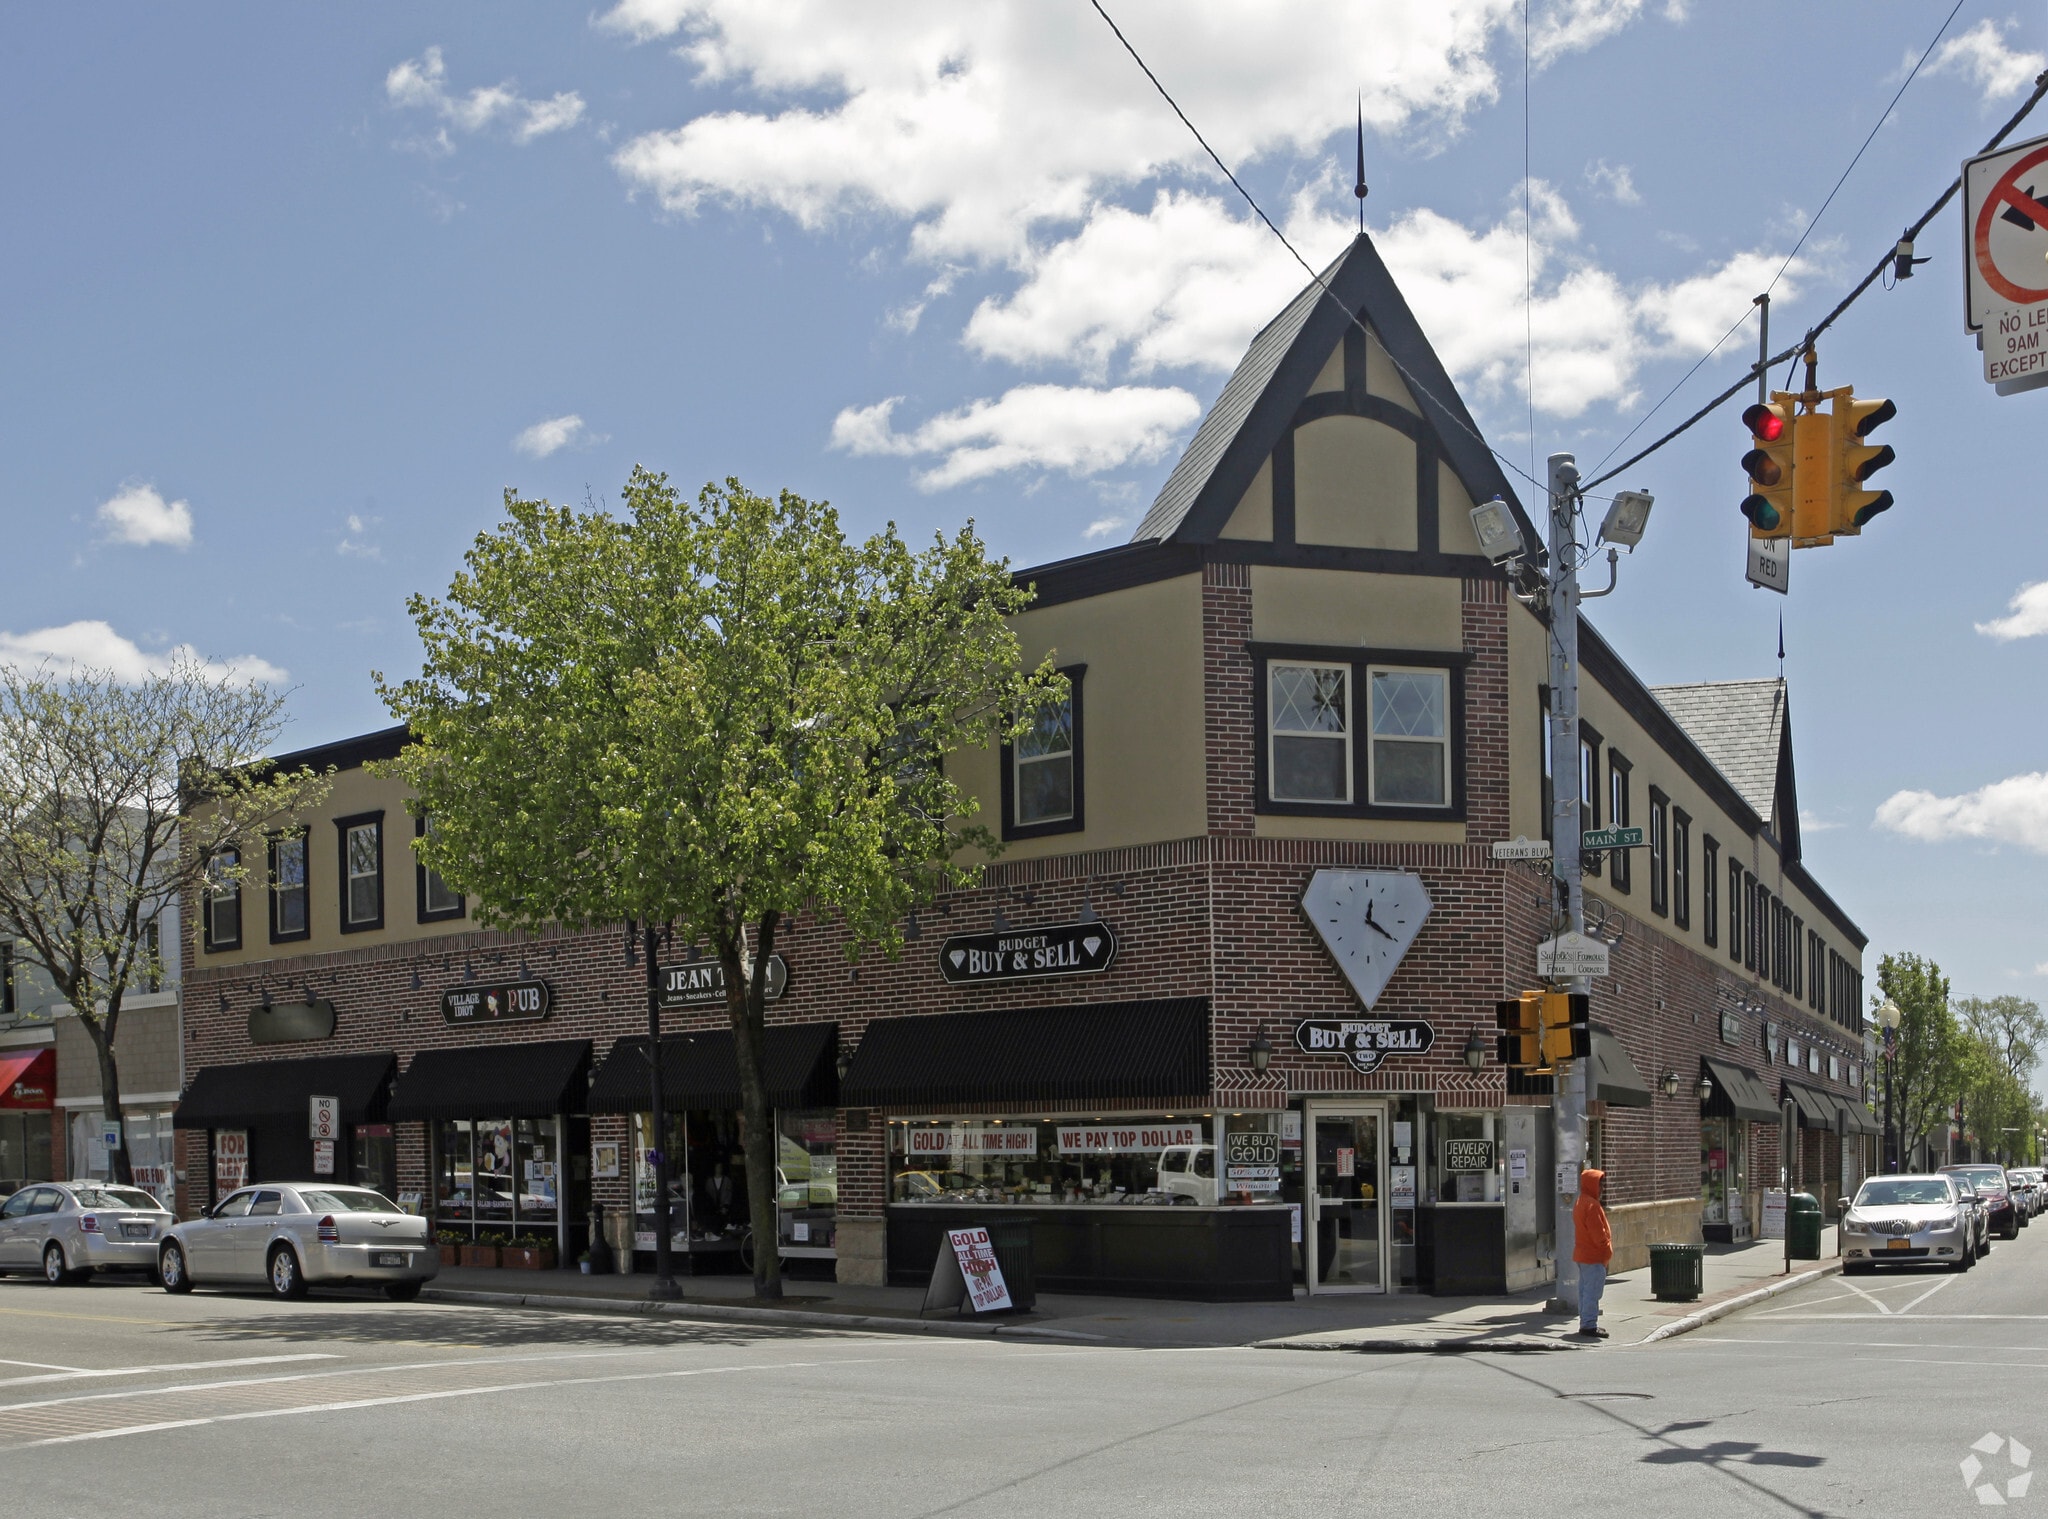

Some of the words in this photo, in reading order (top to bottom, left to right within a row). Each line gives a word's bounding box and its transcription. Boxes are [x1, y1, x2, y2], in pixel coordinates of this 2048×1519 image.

[2000, 315, 2021, 335] NO
[2029, 308, 2048, 328] LE
[2007, 332, 2039, 354] 9AM
[1990, 351, 2047, 379] EXCEPT
[1760, 556, 1777, 578] RED
[1585, 834, 1617, 846] MAIN
[1624, 832, 1641, 843] ST.
[1494, 847, 1529, 858] VETERANS
[1532, 847, 1549, 857] BLVD
[998, 935, 1048, 951] BUDGET
[969, 949, 1006, 974] BUY
[1012, 952, 1028, 970] &
[1034, 939, 1081, 968] SELL
[1577, 951, 1605, 961] Famous
[1578, 964, 1604, 974] Corners
[666, 968, 712, 991] JEAN
[448, 993, 480, 1006] VILLAGE
[507, 987, 540, 1012] PUB
[454, 1005, 474, 1017] IDIOT
[1340, 1022, 1391, 1034] BUDGET
[1309, 1026, 1349, 1048] BUY
[1355, 1033, 1371, 1048] &
[1376, 1028, 1422, 1049] SELL
[319, 1099, 330, 1108] NO
[221, 1135, 245, 1154] FOR
[913, 1132, 944, 1151] GOLD
[945, 1134, 961, 1150] AT
[962, 1133, 979, 1150] ALL
[981, 1133, 1003, 1150] TIME
[1062, 1132, 1081, 1149] WE
[1086, 1131, 1109, 1148] PAY
[1112, 1130, 1137, 1147] TOP
[1141, 1129, 1194, 1147] DOLLAR
[1230, 1135, 1248, 1146] WE
[1251, 1135, 1276, 1146] BUY
[1230, 1146, 1276, 1162] GOLD
[1448, 1142, 1491, 1155] JEWELRY
[218, 1157, 248, 1177] RENT
[1451, 1156, 1487, 1168] REPAIR
[150, 1168, 165, 1184] FOR
[1256, 1168, 1276, 1176] Off
[951, 1231, 989, 1246] GOLD
[957, 1250, 973, 1261] ALL
[972, 1248, 994, 1260] TIME
[972, 1277, 984, 1292] WE
[973, 1293, 985, 1307] TOP
